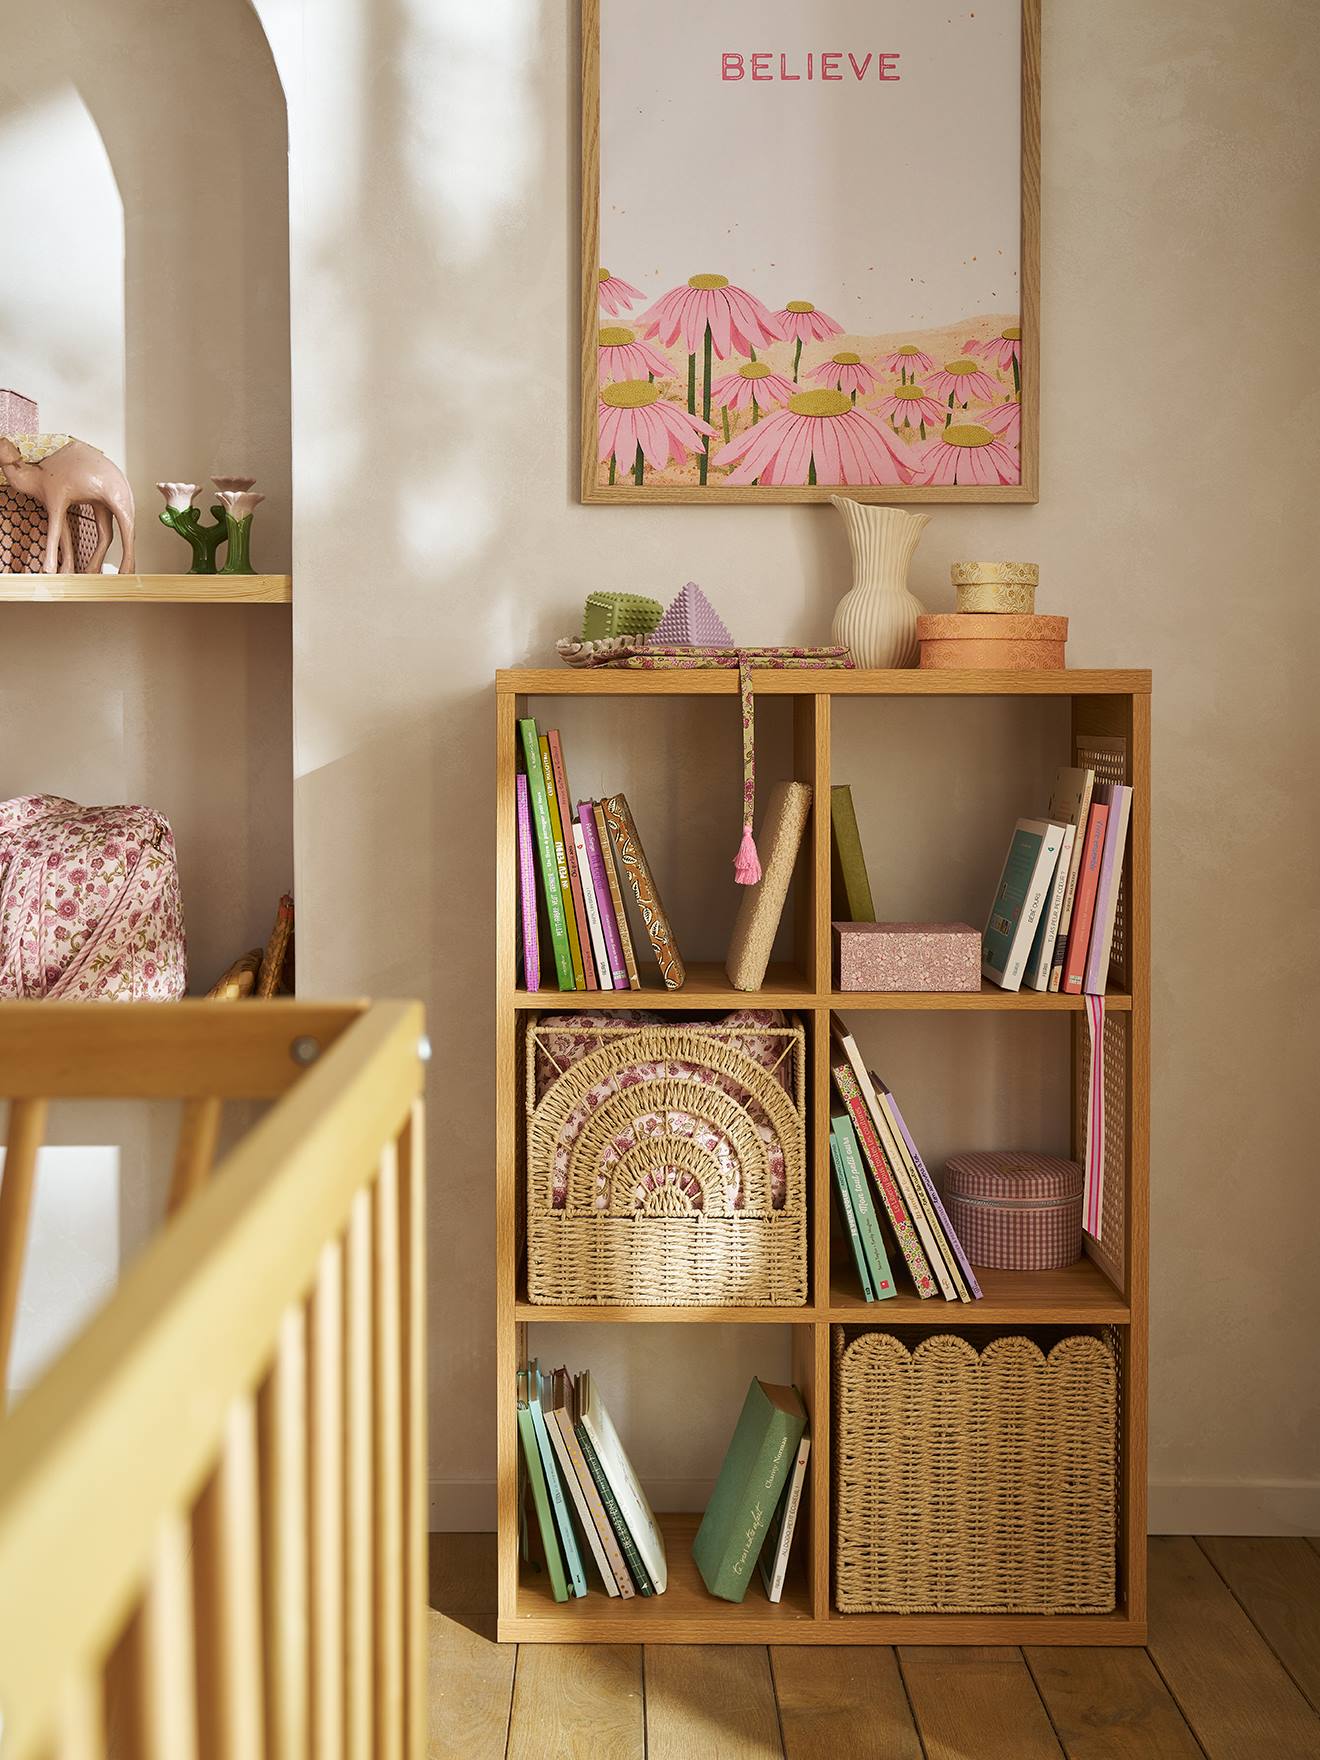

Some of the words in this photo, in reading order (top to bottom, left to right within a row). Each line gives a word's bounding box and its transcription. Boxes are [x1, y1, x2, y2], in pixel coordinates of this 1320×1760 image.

[722, 53, 900, 80] BELIEVE
[554, 839, 565, 864] PERDU
[558, 864, 568, 879] PEU
[1030, 891, 1041, 908] OURS
[853, 1105, 870, 1135] coutures
[840, 1135, 853, 1156] ours
[864, 1134, 874, 1146] les
[845, 1153, 860, 1177] petit
[868, 1144, 882, 1167] toutes
[850, 1174, 863, 1193] tout
[877, 1165, 888, 1182] sous
[854, 1191, 870, 1215] Mon
[771, 1434, 788, 1464] Norman
[763, 1462, 780, 1490] Charity
